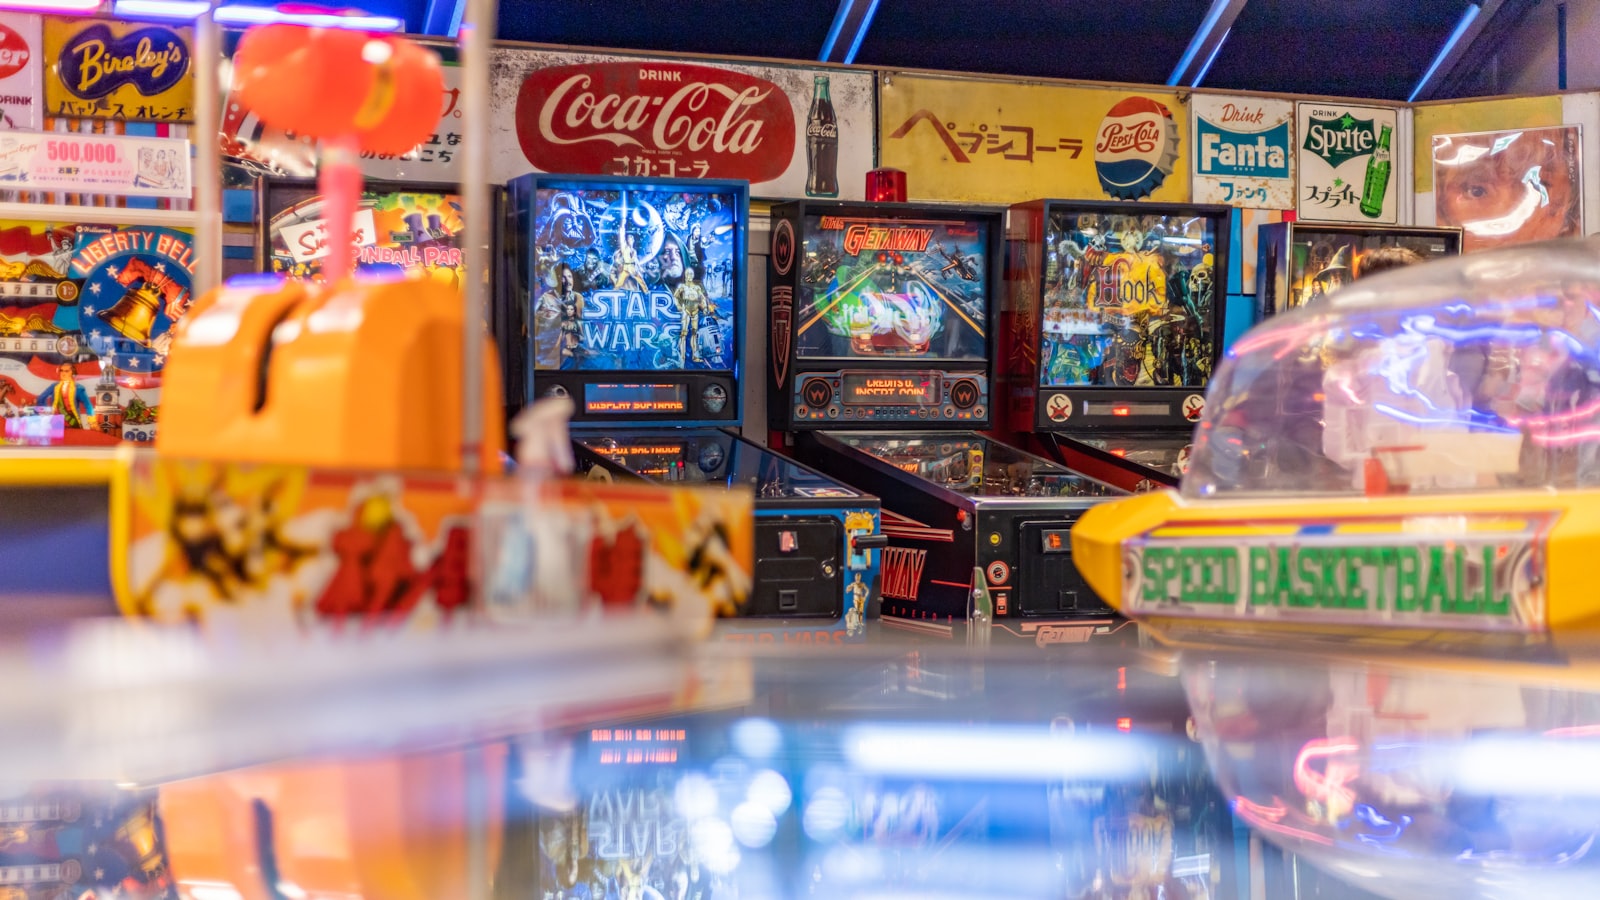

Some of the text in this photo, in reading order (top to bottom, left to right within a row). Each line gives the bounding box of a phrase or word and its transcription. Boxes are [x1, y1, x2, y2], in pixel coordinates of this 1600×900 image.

[72, 37, 182, 91] Bireley's
[638, 68, 682, 82] DRINK
[538, 73, 774, 154] Coca-Cola
[1221, 103, 1265, 124] Drink
[1312, 109, 1338, 118] DRINK
[889, 108, 1083, 163] ペプシコーラ
[1310, 124, 1373, 157] Sprite
[613, 155, 710, 178] コカ・コーラ
[1201, 132, 1285, 171] Fanta
[1219, 182, 1267, 202] ファンタ
[1305, 183, 1361, 208] スプライト
[71, 231, 154, 274] LIBERTY
[350, 246, 465, 269] PINBALL PAR
[1095, 257, 1162, 307] Hook
[583, 289, 682, 319] STAR
[583, 322, 682, 351] WARS
[1141, 546, 1511, 616] SPEED BASKETBALL
